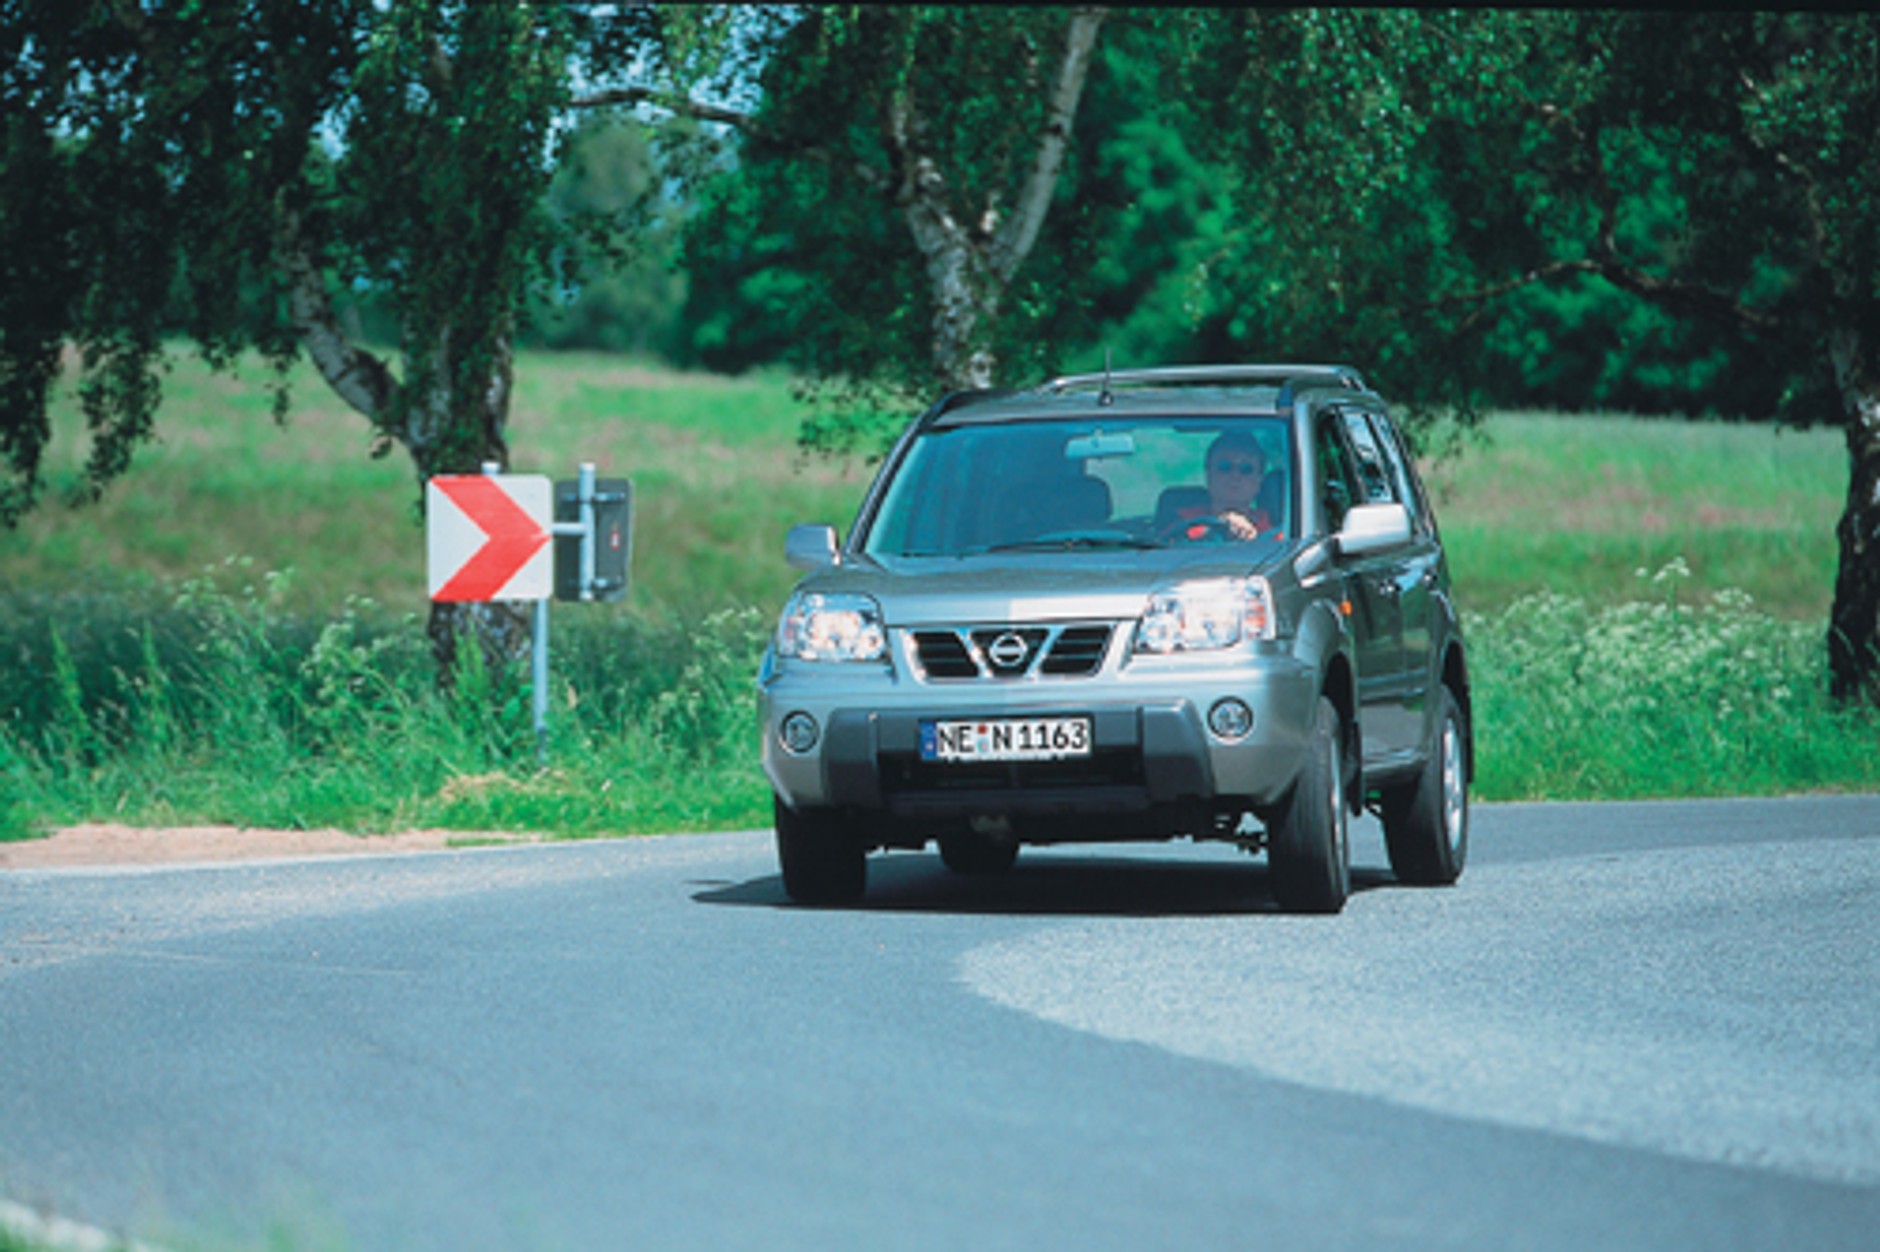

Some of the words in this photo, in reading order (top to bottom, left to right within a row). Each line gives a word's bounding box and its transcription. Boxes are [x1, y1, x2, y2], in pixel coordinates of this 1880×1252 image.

[938, 725, 975, 753] NE
[992, 724, 1013, 750] N
[1018, 722, 1088, 750] 1163
